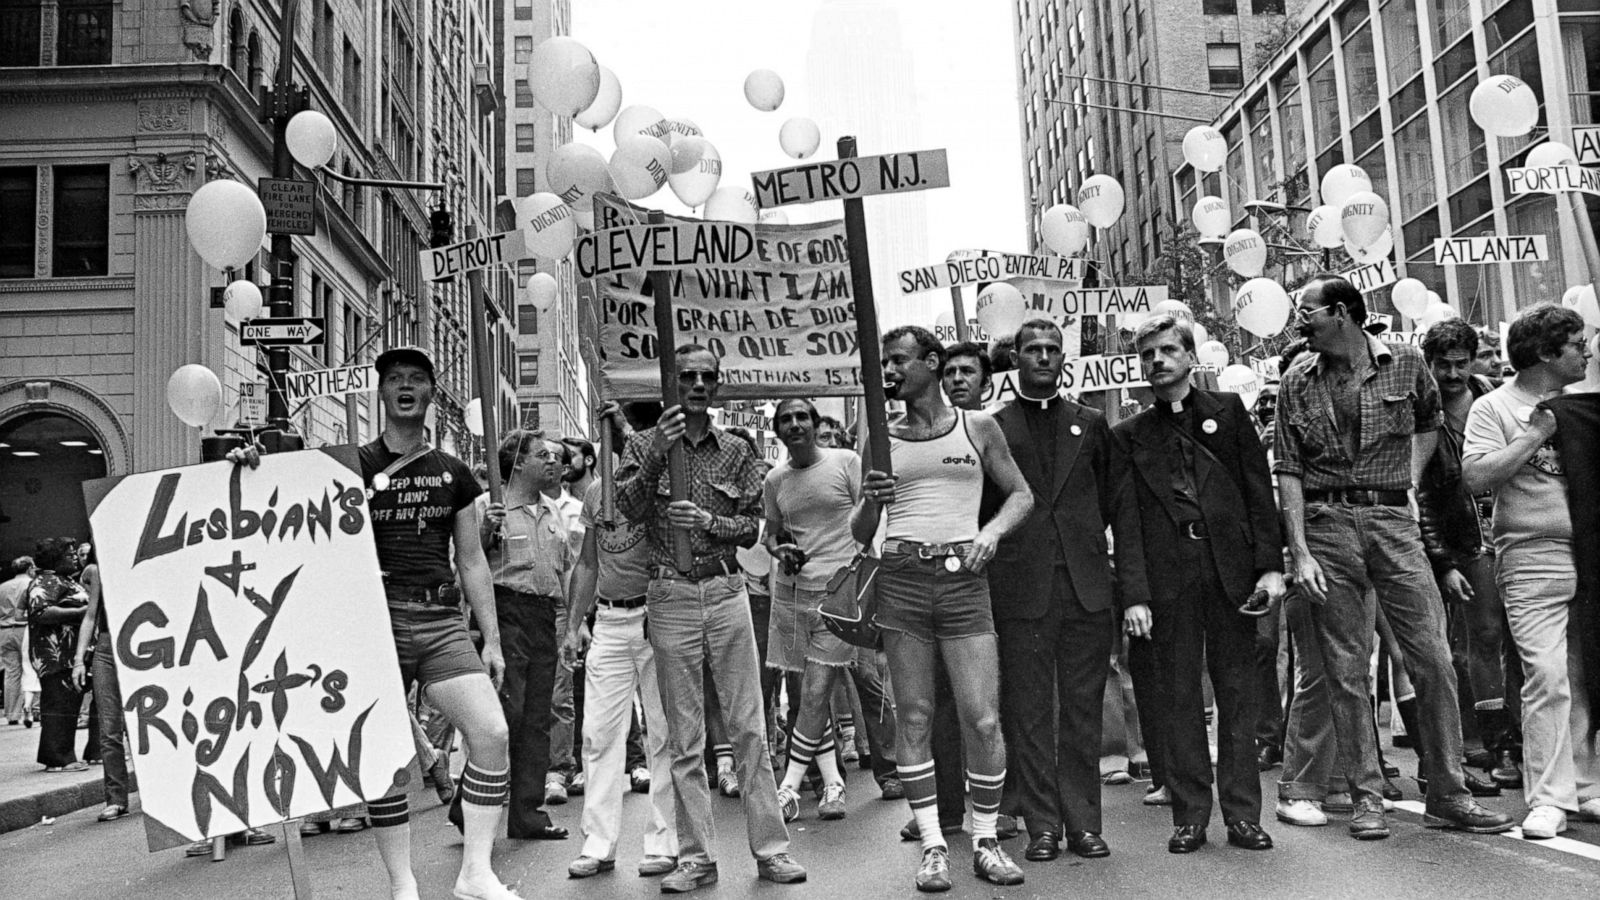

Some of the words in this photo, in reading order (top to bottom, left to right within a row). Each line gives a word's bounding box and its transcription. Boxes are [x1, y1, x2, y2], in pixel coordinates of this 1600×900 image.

[271, 183, 304, 193] CLEAR
[753, 161, 861, 208] METRO
[879, 153, 928, 190] N.J.
[1510, 166, 1600, 192] PORTLAN
[263, 192, 283, 202] FIRE
[289, 194, 311, 203] LANE
[266, 208, 312, 219] MERGENCY
[529, 203, 571, 234] DIGNITY
[432, 234, 506, 278] DETROIT
[577, 225, 755, 279] CLEVELAND
[777, 241, 803, 263] OF
[1226, 237, 1257, 257] DIGNITY
[1440, 237, 1539, 263] ATLANTA
[900, 267, 938, 293] SAN
[948, 258, 1000, 285] DIEGO
[1057, 261, 1077, 280] PA.
[1349, 260, 1384, 291] CITY
[695, 268, 773, 303] WHAT
[779, 271, 803, 301] I
[810, 270, 850, 301] AM
[1063, 287, 1151, 315] OTTAWA
[602, 297, 649, 327] POR
[676, 308, 759, 332] GRACIA
[764, 306, 799, 330] DE
[246, 327, 271, 338] ONE
[287, 326, 312, 337] WAY
[738, 335, 793, 360] QUE
[240, 382, 254, 397] NO
[286, 365, 374, 399] NORTHEAST
[724, 412, 773, 431] MILWAUK
[387, 476, 410, 490] EEP
[413, 476, 443, 487] YOUR
[397, 490, 429, 504] LAWS
[370, 509, 393, 521] OFF
[395, 507, 416, 520] MY
[116, 564, 304, 671] GAY
[191, 698, 379, 839] NOW
